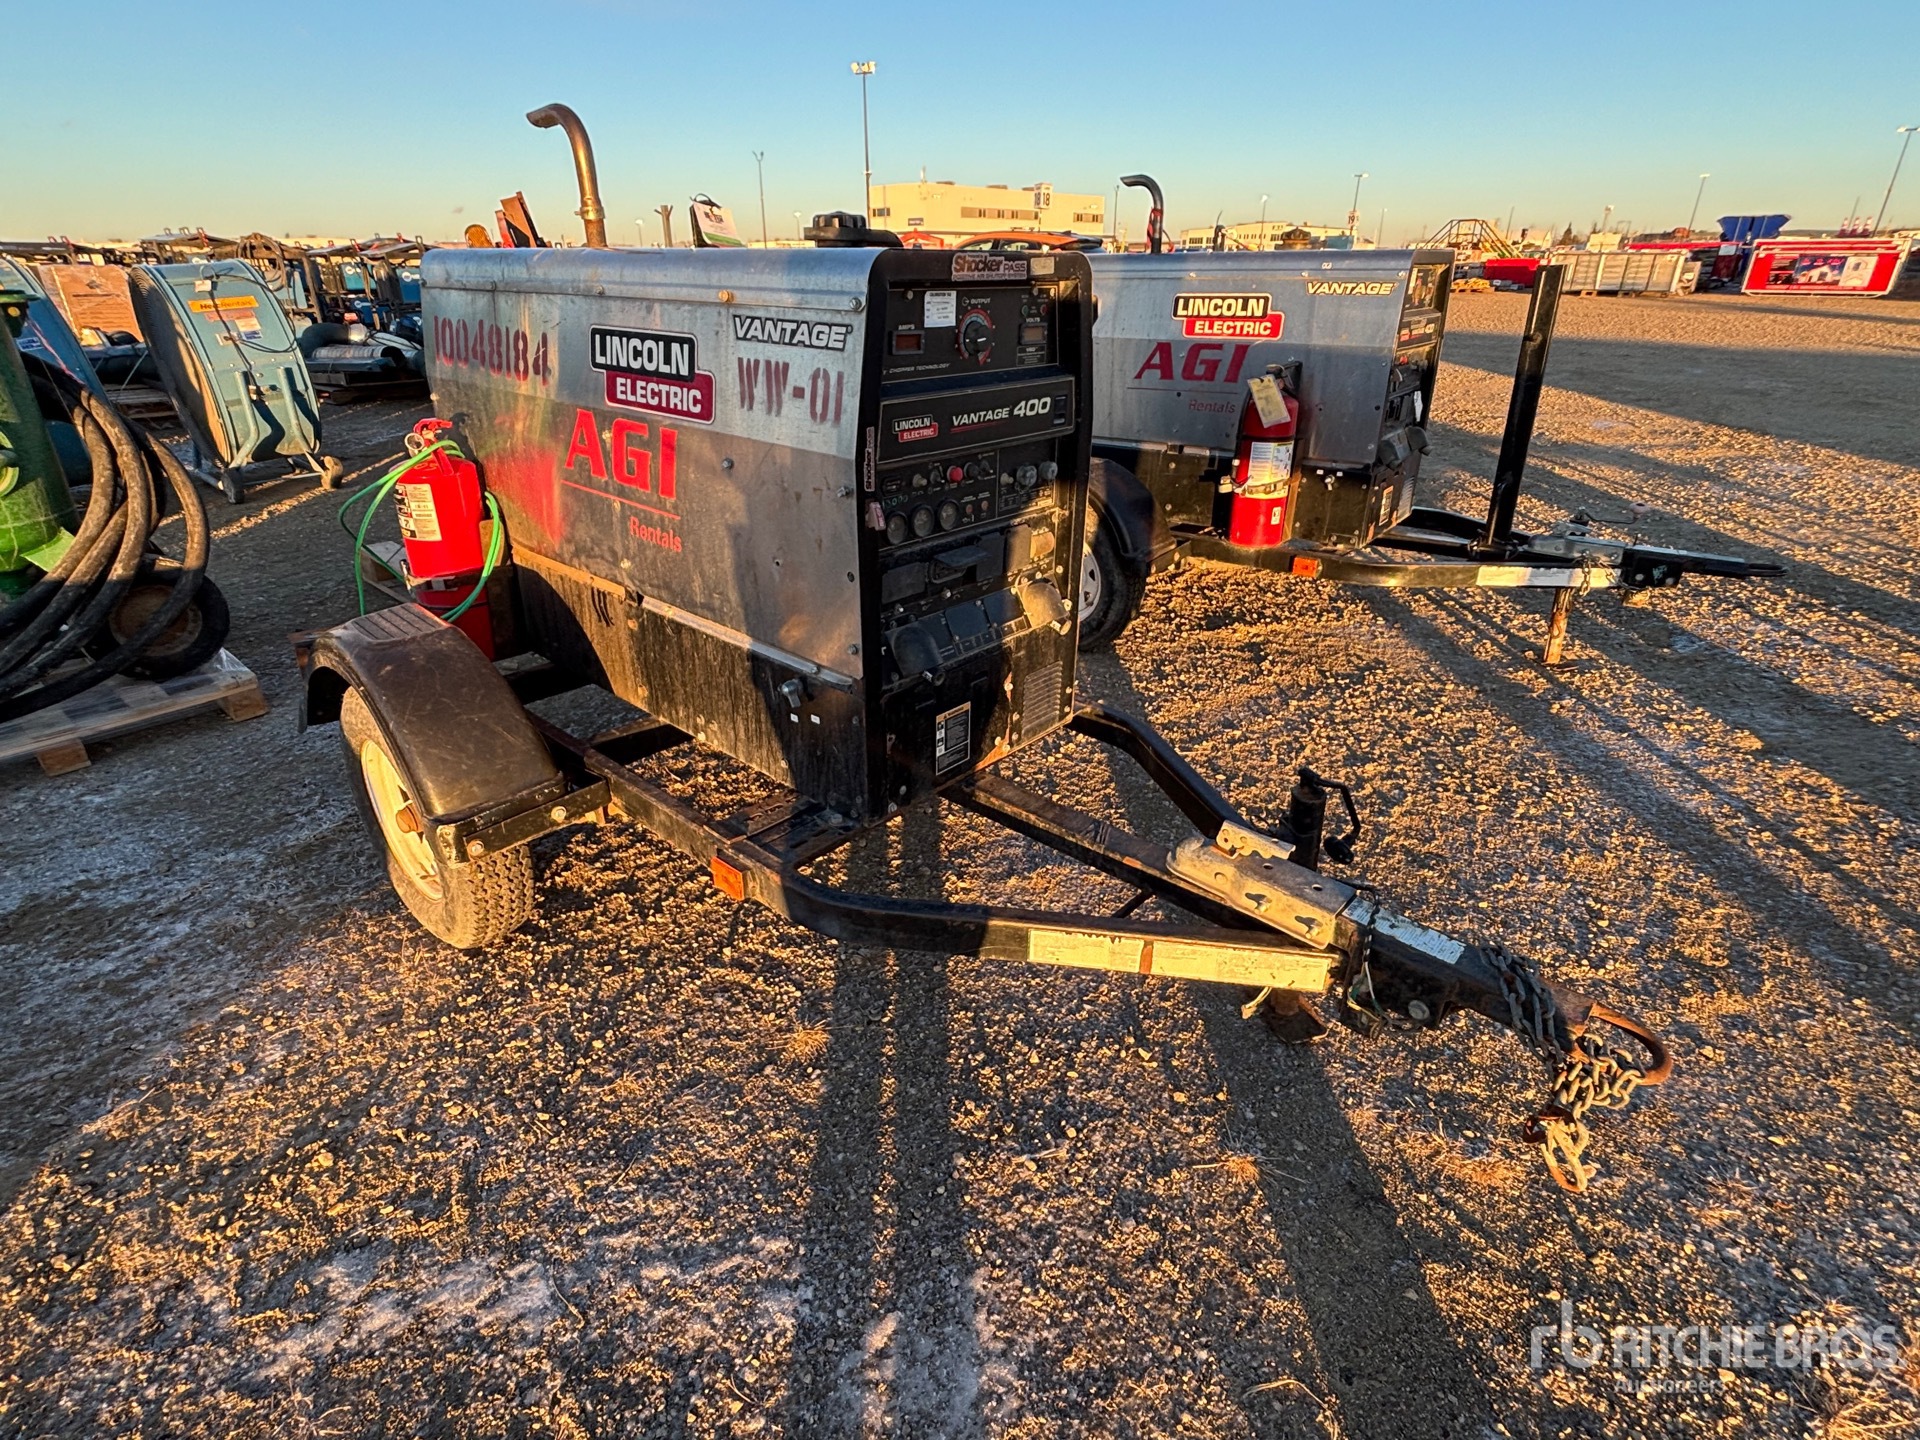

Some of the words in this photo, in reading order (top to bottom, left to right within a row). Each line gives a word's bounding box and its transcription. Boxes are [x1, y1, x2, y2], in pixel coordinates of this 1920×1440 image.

[1043, 192, 1050, 206] 18
[954, 253, 1003, 273] Shocker
[1003, 262, 1026, 272] PASS
[1307, 282, 1393, 295] VANTAGE
[1177, 298, 1265, 317] LINCOLN
[734, 316, 847, 349] VANTAGE
[1194, 321, 1272, 335] ELECTRIC
[595, 333, 691, 376] LINCOLN
[1134, 342, 1250, 383] AGI
[616, 377, 702, 414] ELECTRIC
[738, 356, 845, 426] WW-01
[952, 407, 1010, 426] VANTAGE
[1013, 397, 1052, 417] 400
[1188, 400, 1236, 414] Rentals
[895, 417, 931, 432] LINCOLN
[903, 428, 935, 440] ELECTRIC
[564, 408, 678, 500] AGI
[630, 516, 682, 552] Rentals
